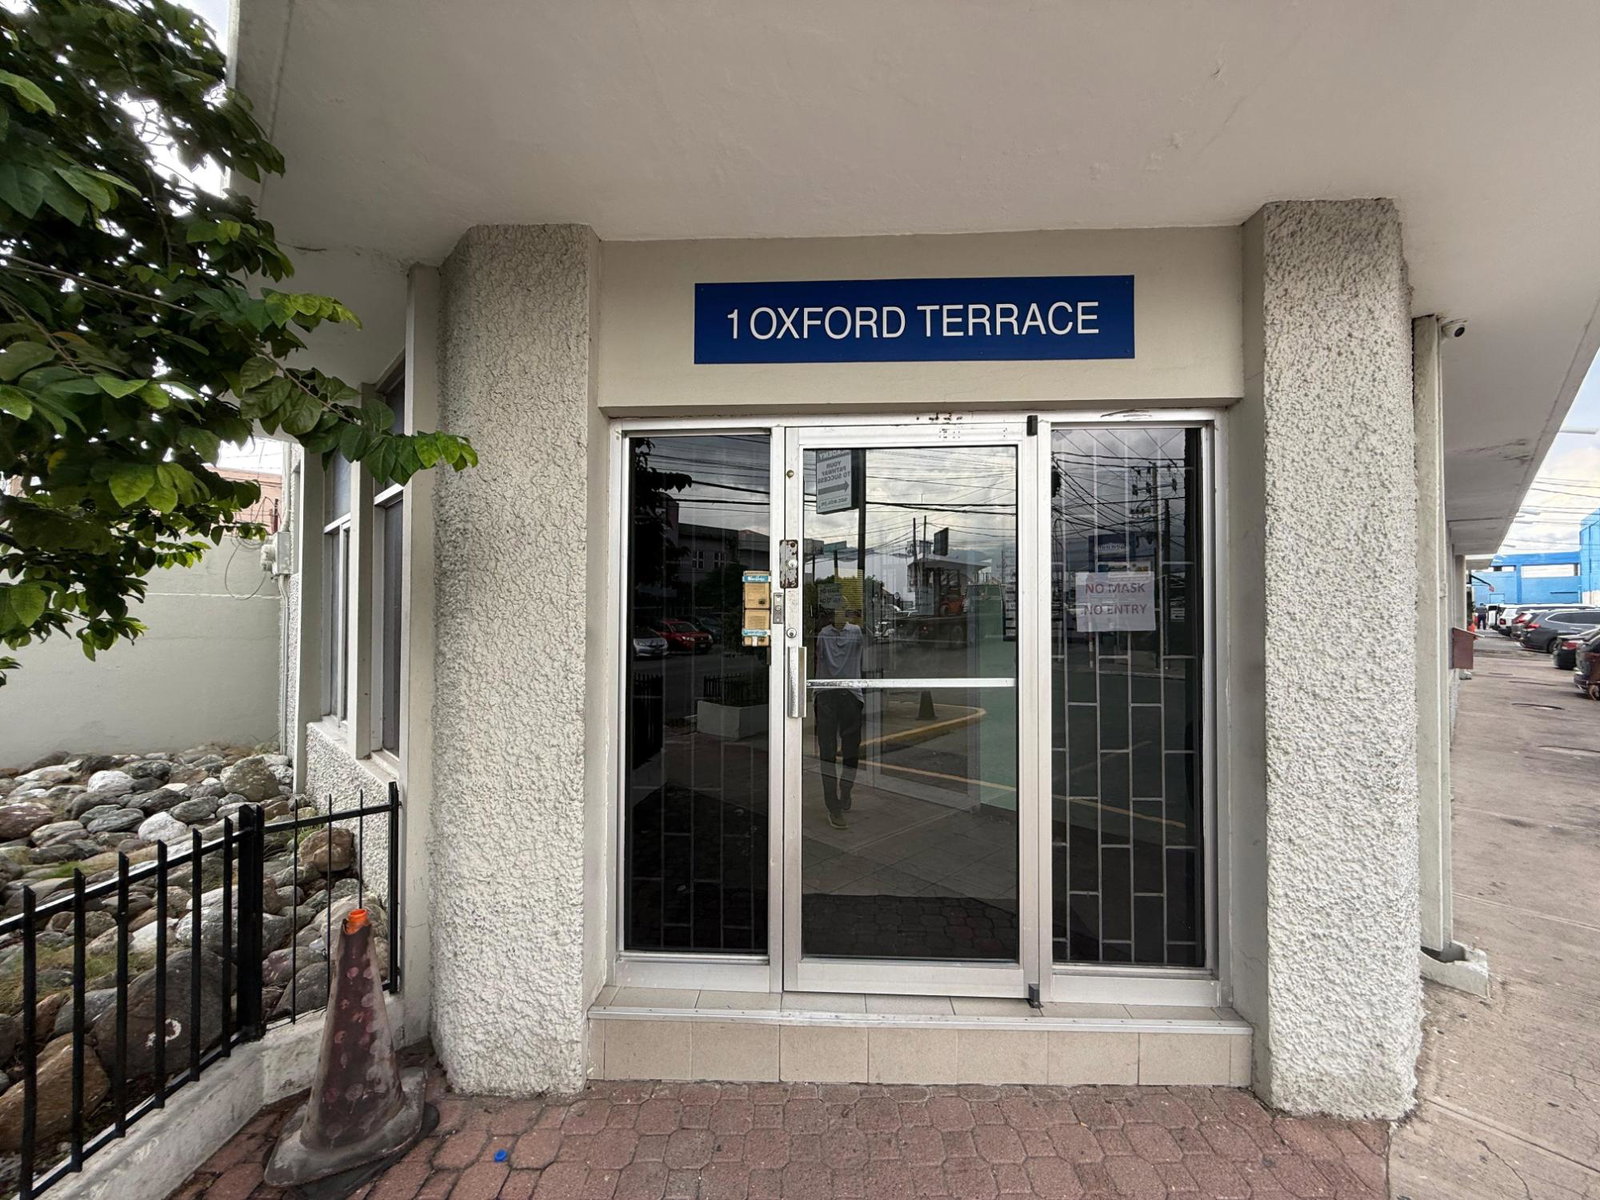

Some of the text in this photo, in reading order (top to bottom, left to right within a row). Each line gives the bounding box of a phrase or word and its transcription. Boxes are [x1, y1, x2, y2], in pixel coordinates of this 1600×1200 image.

[727, 301, 1100, 340] 1 OXFORD TERRACE
[1085, 583, 1146, 594] NO MASK
[1084, 603, 1148, 615] NO ENTRY
